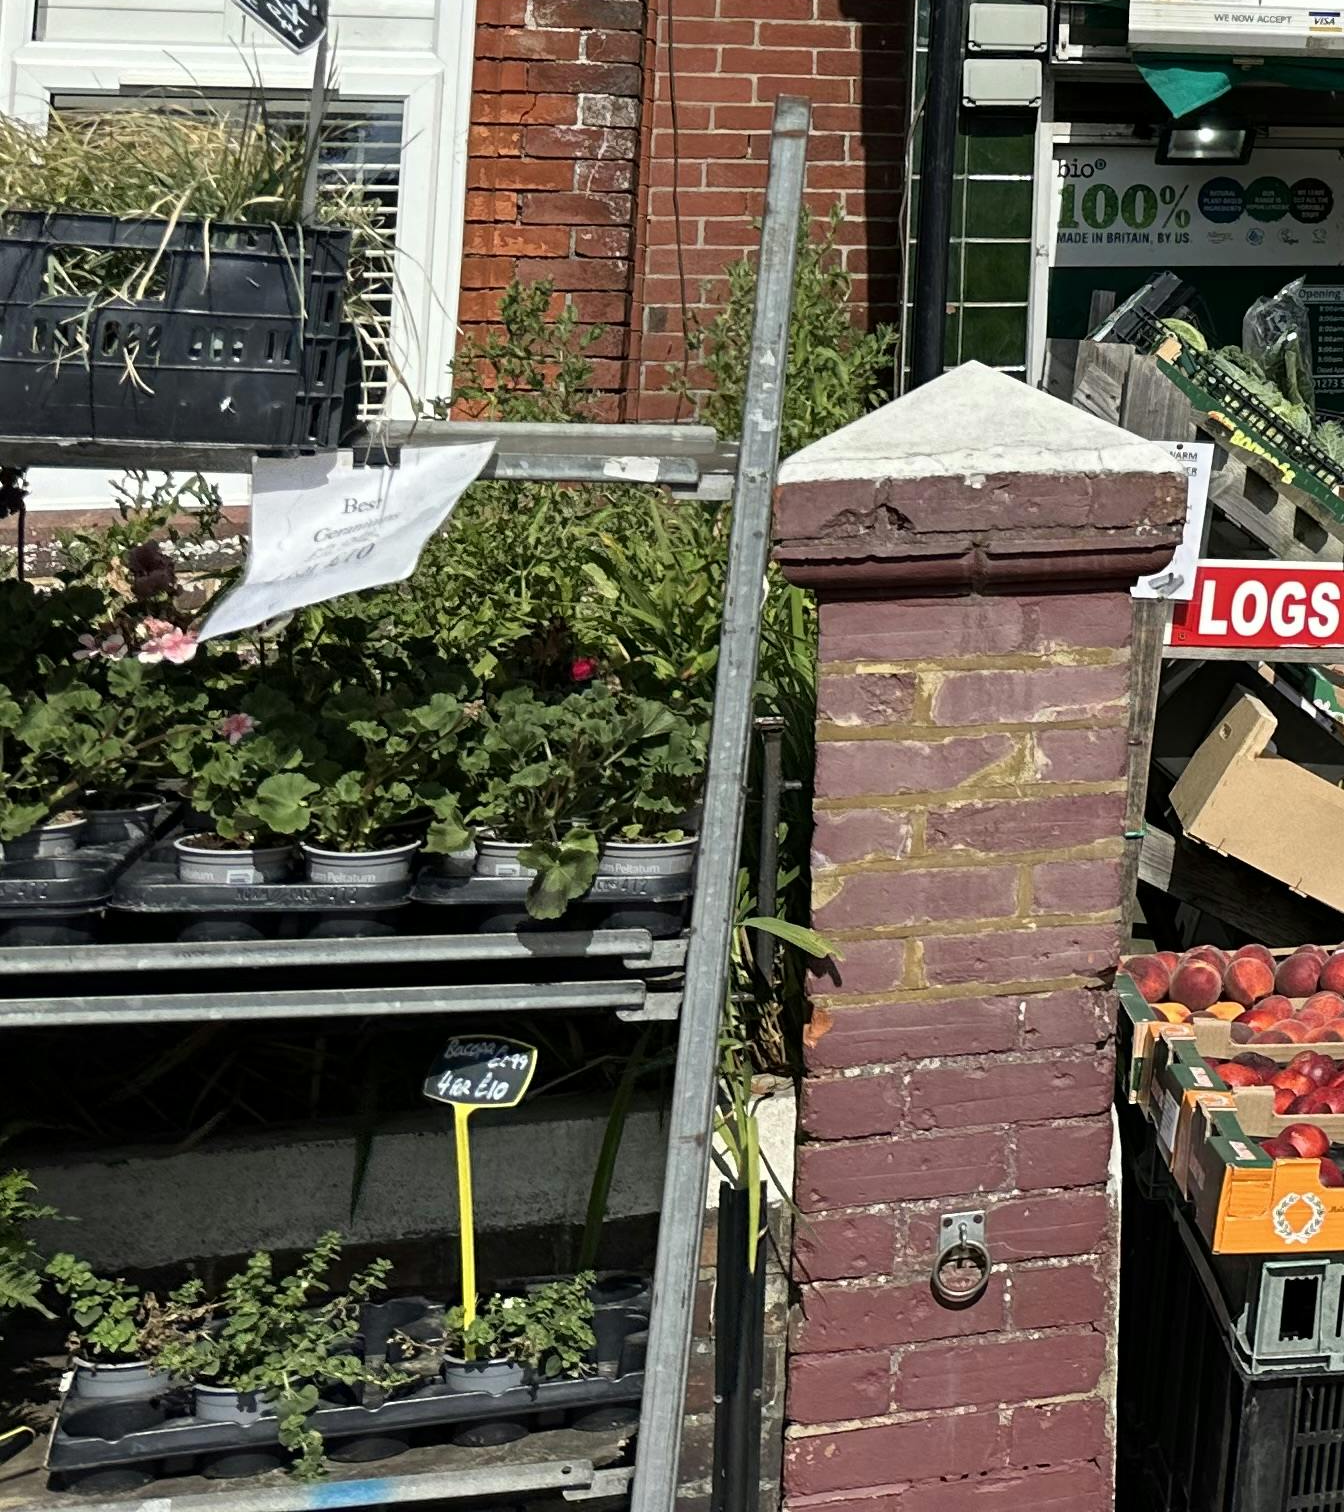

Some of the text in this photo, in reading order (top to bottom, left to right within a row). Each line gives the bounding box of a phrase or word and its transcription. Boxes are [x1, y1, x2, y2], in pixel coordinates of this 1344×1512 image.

[1214, 13, 1292, 24] WE NOW ACCEPT
[1313, 17, 1336, 26] VISA
[1057, 183, 1192, 230] 100%
[1057, 232, 1089, 245] MADE
[1092, 232, 1103, 244] IN
[1157, 233, 1172, 244] BY
[1300, 289, 1341, 300] Opening
[343, 497, 383, 514] Best
[1197, 579, 1341, 638] LOGS
